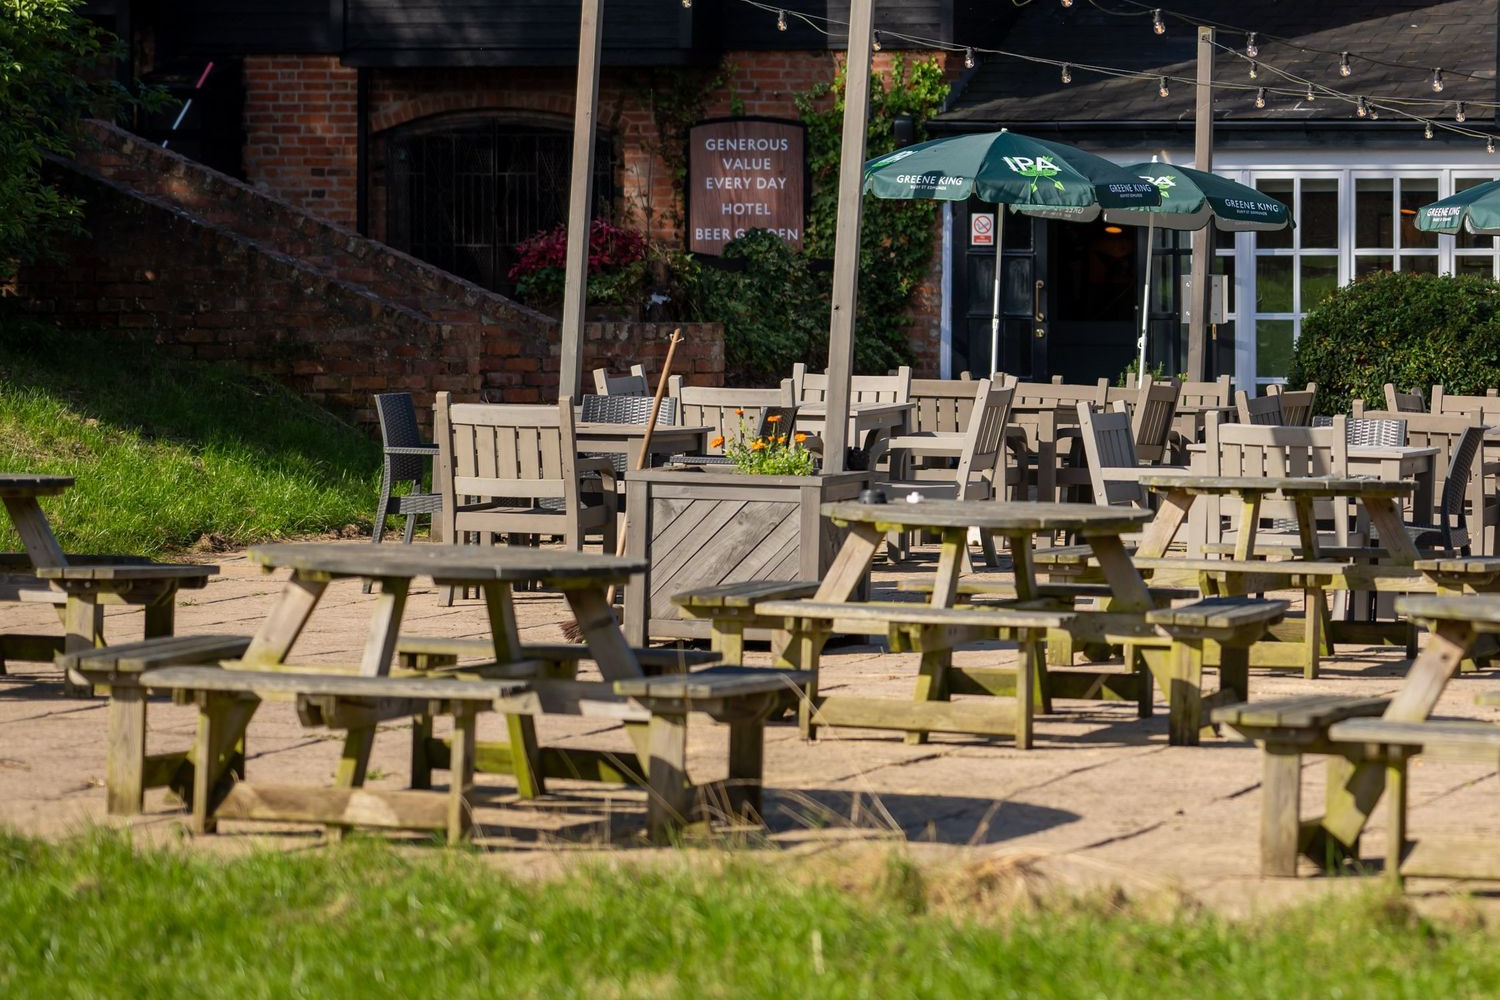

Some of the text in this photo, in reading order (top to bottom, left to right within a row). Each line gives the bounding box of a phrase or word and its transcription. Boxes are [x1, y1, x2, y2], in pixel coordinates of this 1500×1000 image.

[705, 138, 788, 151] GENEROUS
[722, 158, 771, 170] VALUE
[1002, 156, 1062, 172] IPA
[706, 177, 787, 190] EVERY DAY
[896, 174, 964, 186] GREENE KING
[1109, 183, 1152, 193] GREENE KING
[721, 203, 771, 215] HOTEL
[1225, 198, 1279, 213] GREENE KING
[1427, 206, 1461, 217] GREENE KING
[695, 228, 798, 241] BEER GEN
